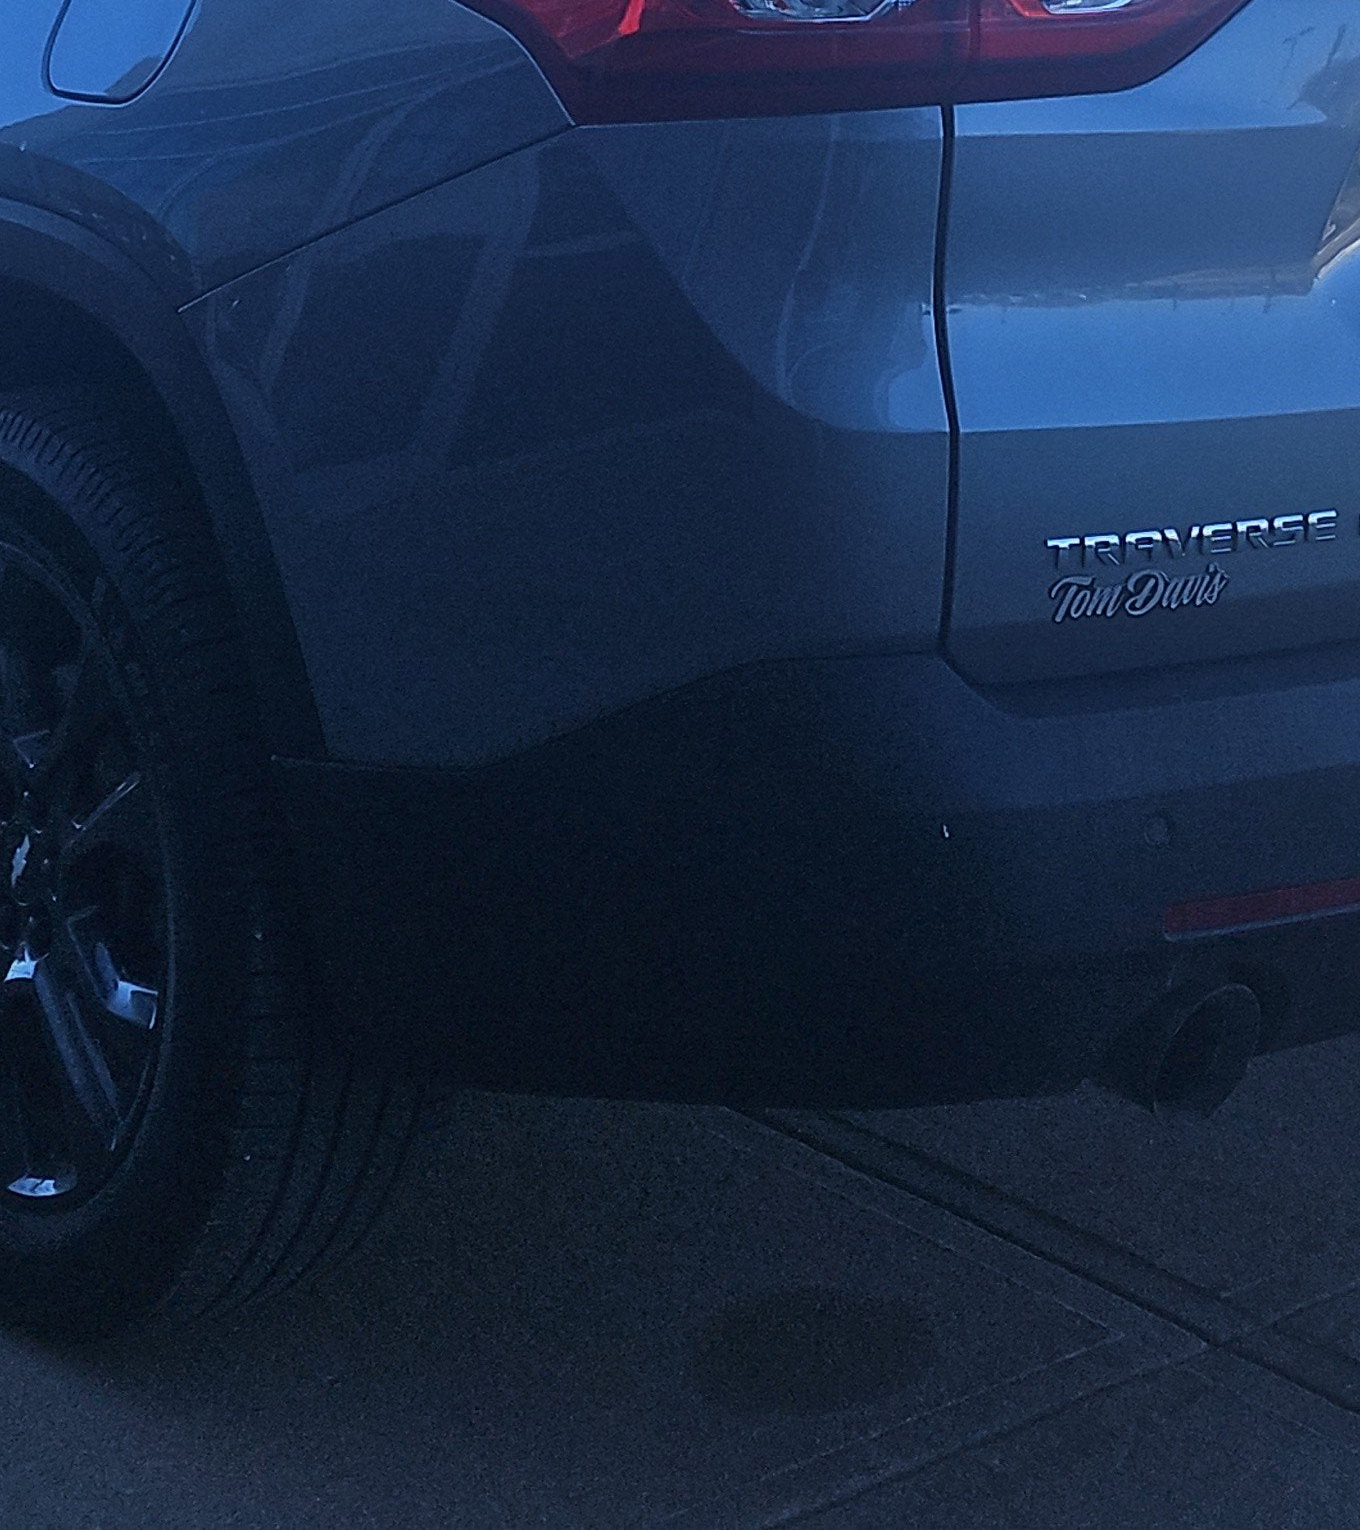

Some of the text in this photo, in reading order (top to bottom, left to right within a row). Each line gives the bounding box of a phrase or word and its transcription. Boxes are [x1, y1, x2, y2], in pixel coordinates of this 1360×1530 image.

[1044, 509, 1339, 569] TRAVERSE
[1048, 563, 1230, 623] Tom Davis
